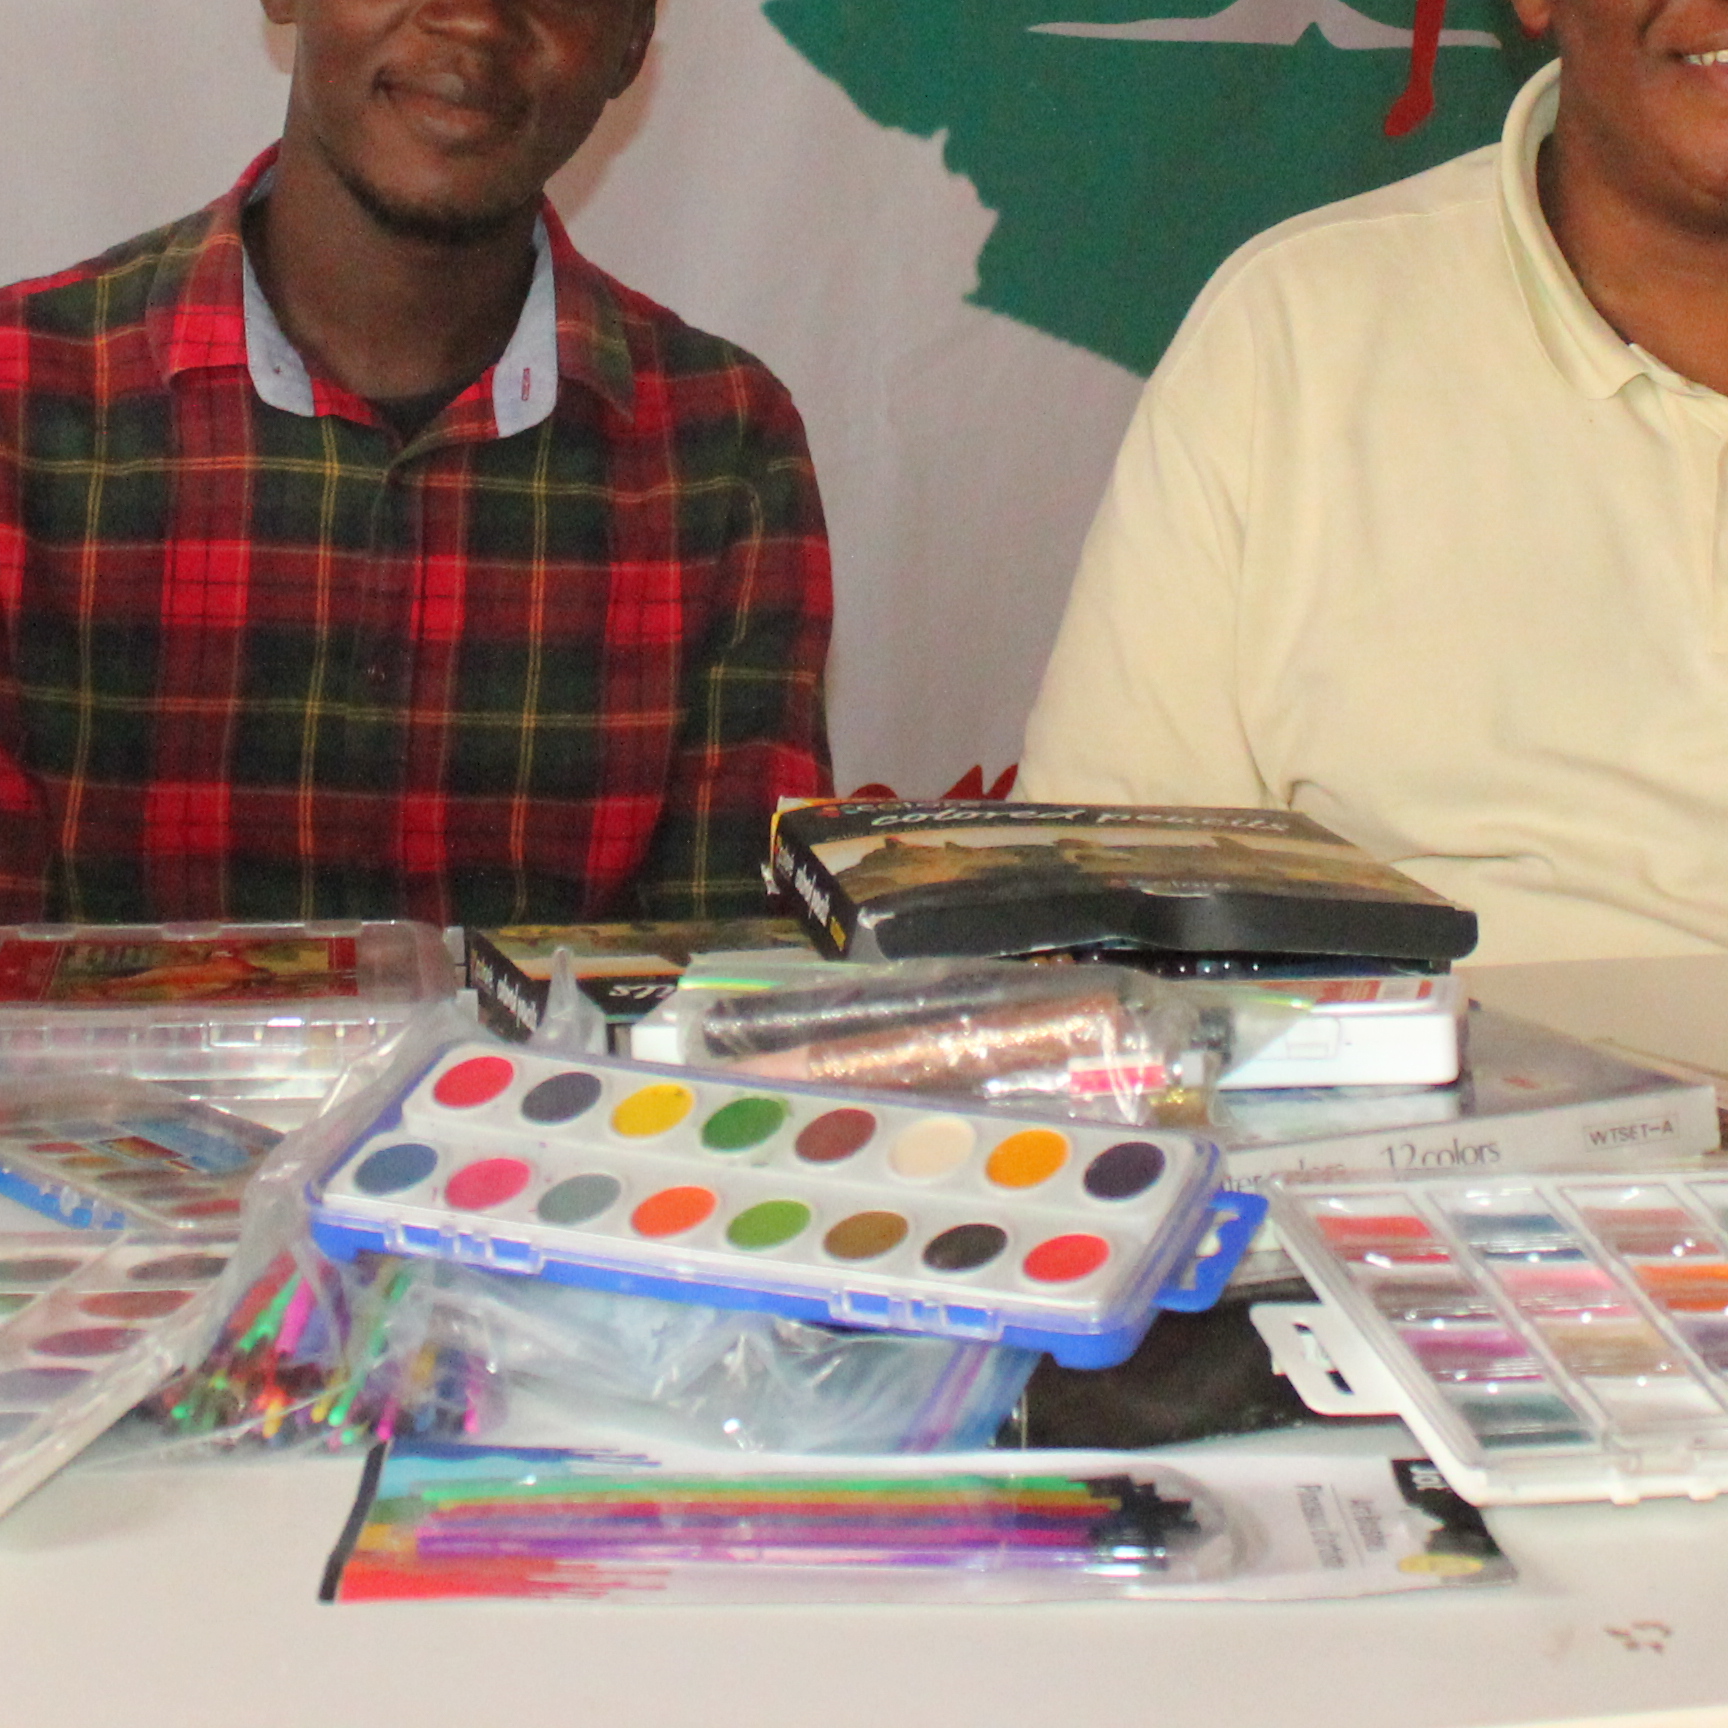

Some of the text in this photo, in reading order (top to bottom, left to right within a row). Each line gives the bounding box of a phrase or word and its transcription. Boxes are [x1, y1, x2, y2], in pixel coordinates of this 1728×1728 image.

[871, 808, 1290, 834] colored pencils
[1586, 1119, 1674, 1147] WTSET-A
